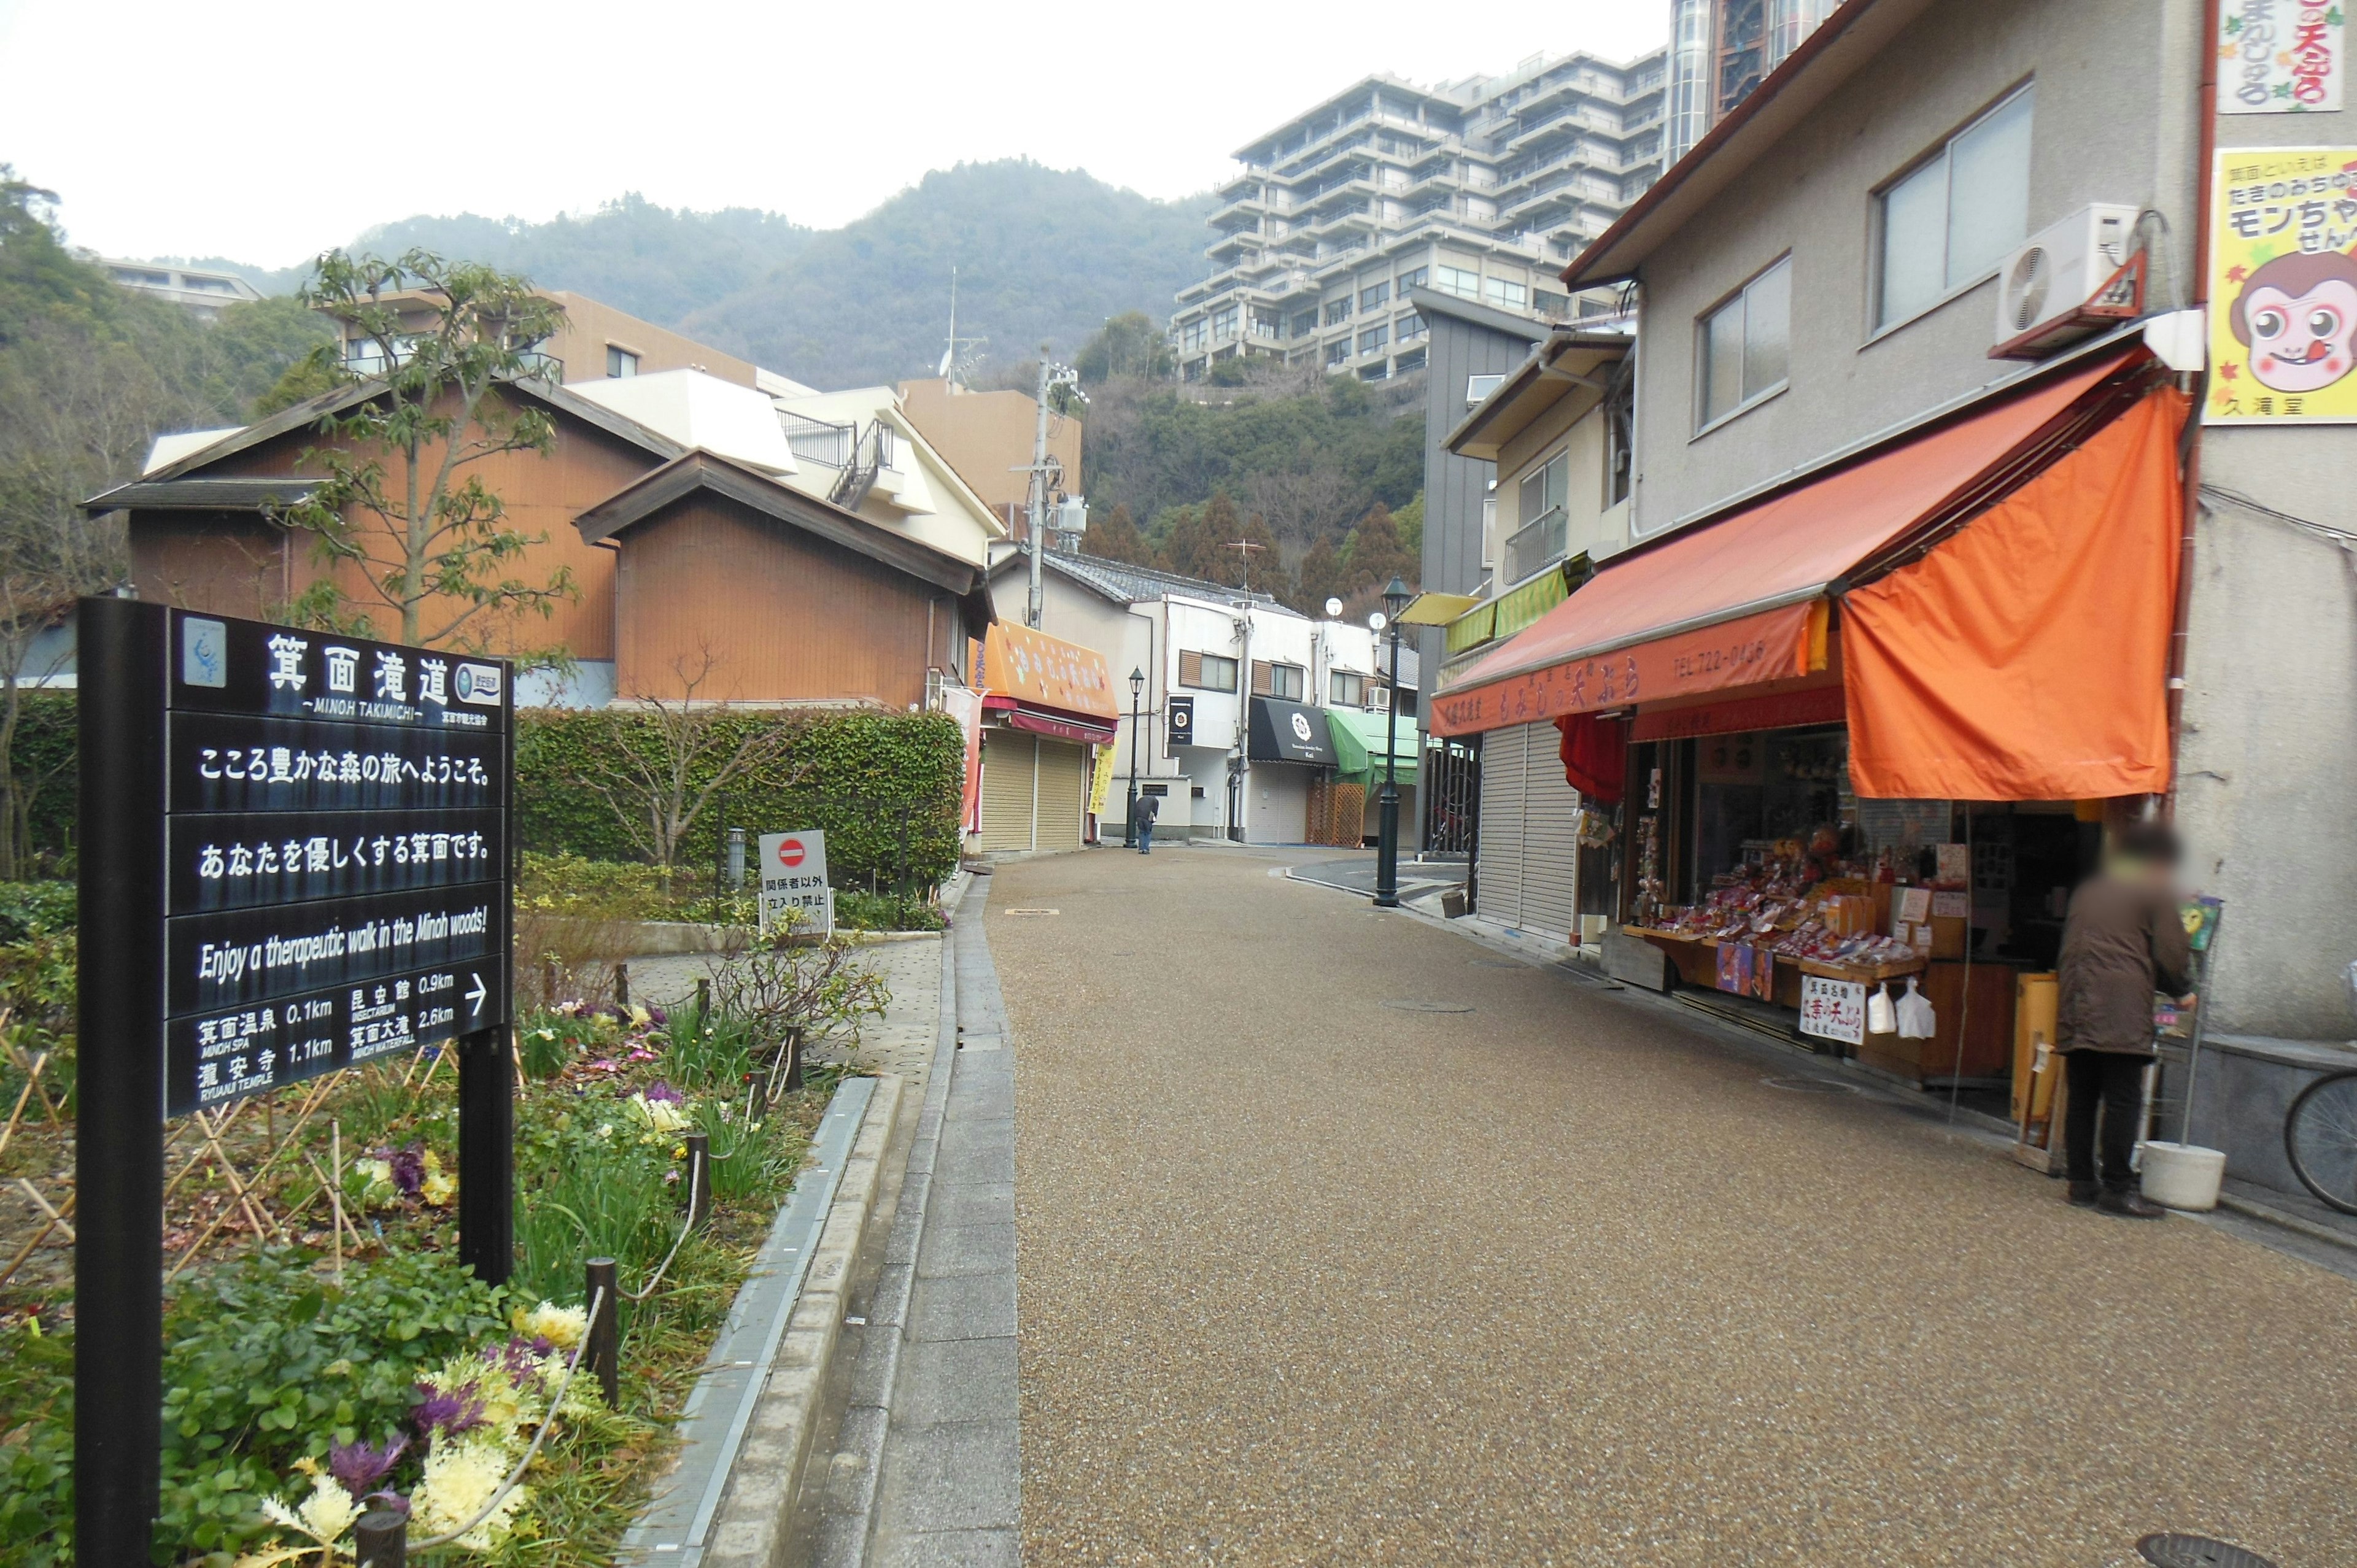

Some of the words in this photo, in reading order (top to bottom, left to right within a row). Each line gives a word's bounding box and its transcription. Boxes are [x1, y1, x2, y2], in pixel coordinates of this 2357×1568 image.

[2292, 0, 2332, 104] の天ぷら
[2229, 155, 2328, 183] 箕面といえば
[268, 634, 448, 705] 箕面滝道
[1500, 656, 1638, 722] もみじの天ぷら
[200, 748, 488, 786] こころ豊かな森の旅へようこそ。
[200, 832, 488, 879] あなたを優しくする箕面です。
[766, 875, 823, 891] 関係者以外
[768, 894, 824, 910] 立入り禁止
[199, 940, 247, 985] Enjoy
[250, 948, 261, 971] a
[266, 925, 345, 969] therapeutic
[349, 921, 376, 953] walk
[379, 918, 390, 946] in
[393, 916, 412, 945] the
[416, 911, 448, 942] Minoh
[451, 905, 487, 938] woods!
[351, 979, 411, 1011] 昆虫館
[418, 973, 454, 995] 0.9km
[198, 1007, 277, 1045] 箕面温泉
[286, 1000, 332, 1026] 0.1km
[418, 1006, 454, 1030] 2.6km
[289, 1037, 332, 1064] 1.1km
